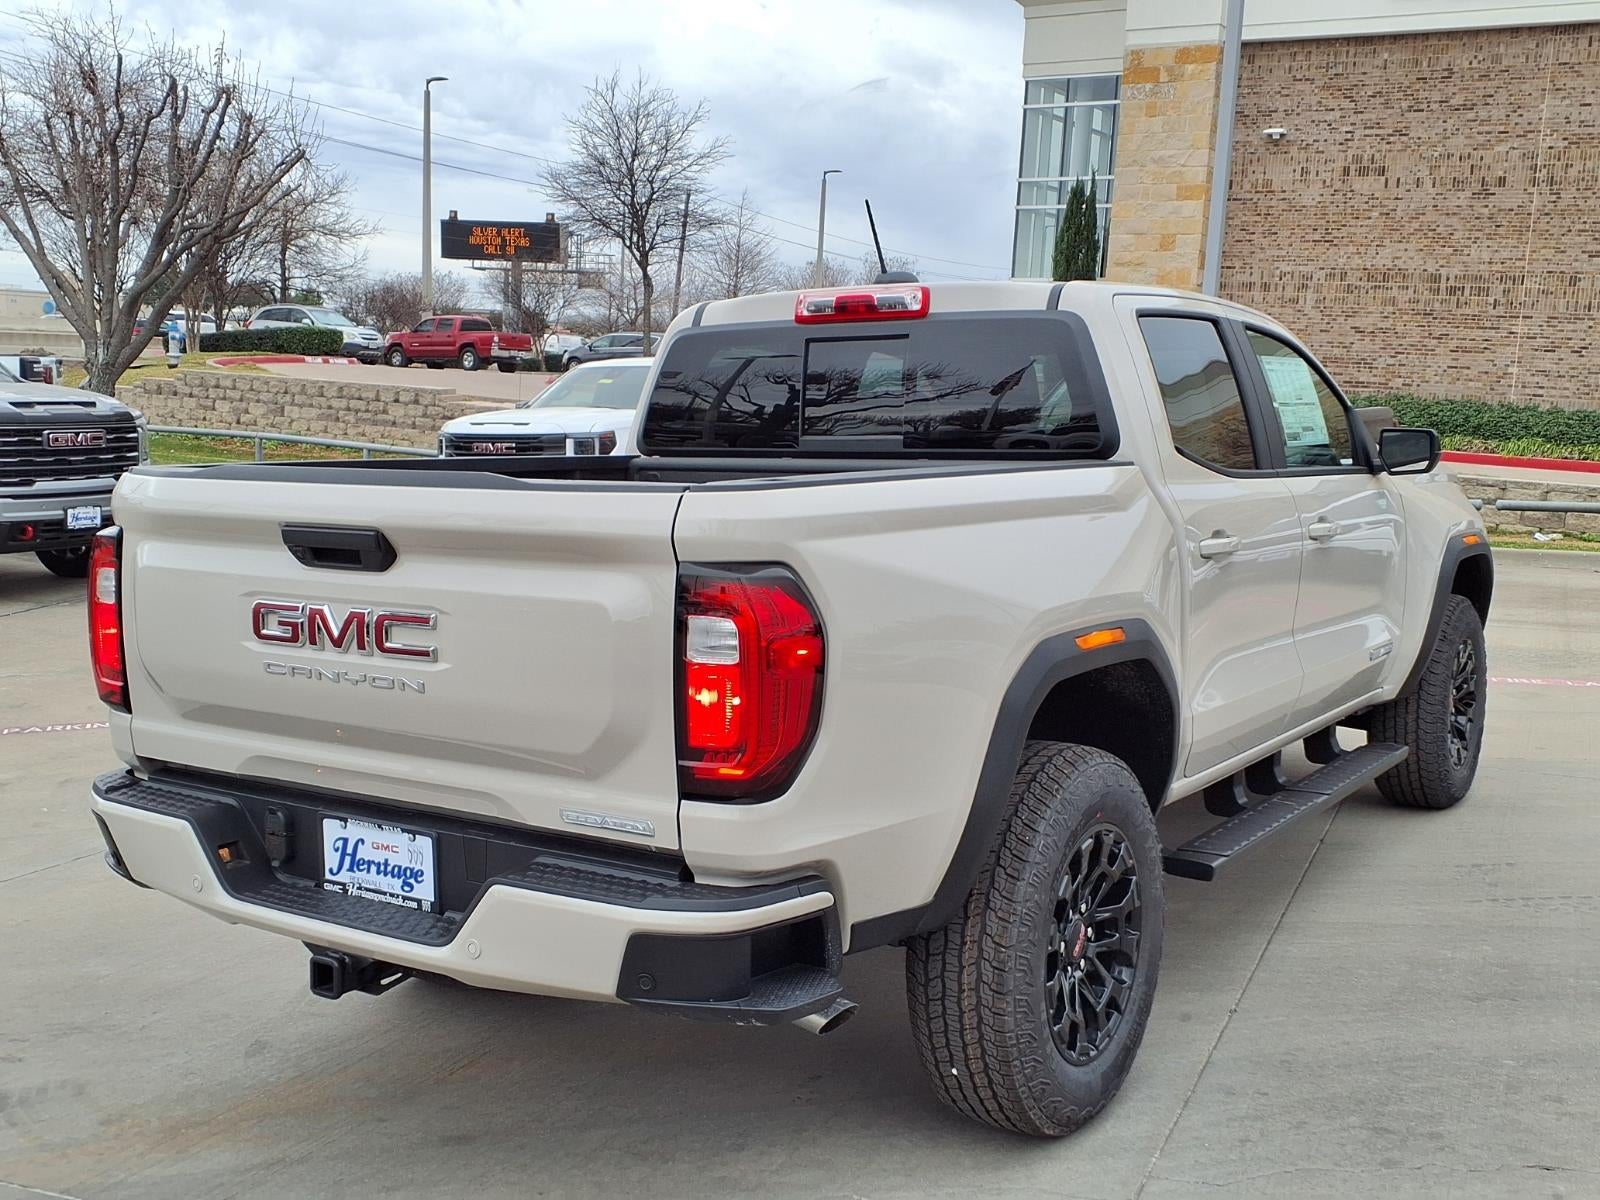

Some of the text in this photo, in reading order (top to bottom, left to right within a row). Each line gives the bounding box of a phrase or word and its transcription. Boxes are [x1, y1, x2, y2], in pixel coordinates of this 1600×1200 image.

[473, 227, 525, 237] SILVER ALERT
[469, 236, 530, 247] HOUSTON TEXAS
[483, 246, 515, 256] CALL 911
[49, 432, 105, 447] GMC
[472, 442, 516, 455] GMC
[252, 598, 439, 663] GMC
[262, 660, 426, 694] CANYON
[566, 812, 649, 832] ELEVATION
[371, 841, 399, 853] GMC
[328, 836, 425, 894] Heritage
[323, 882, 343, 893] GMC
